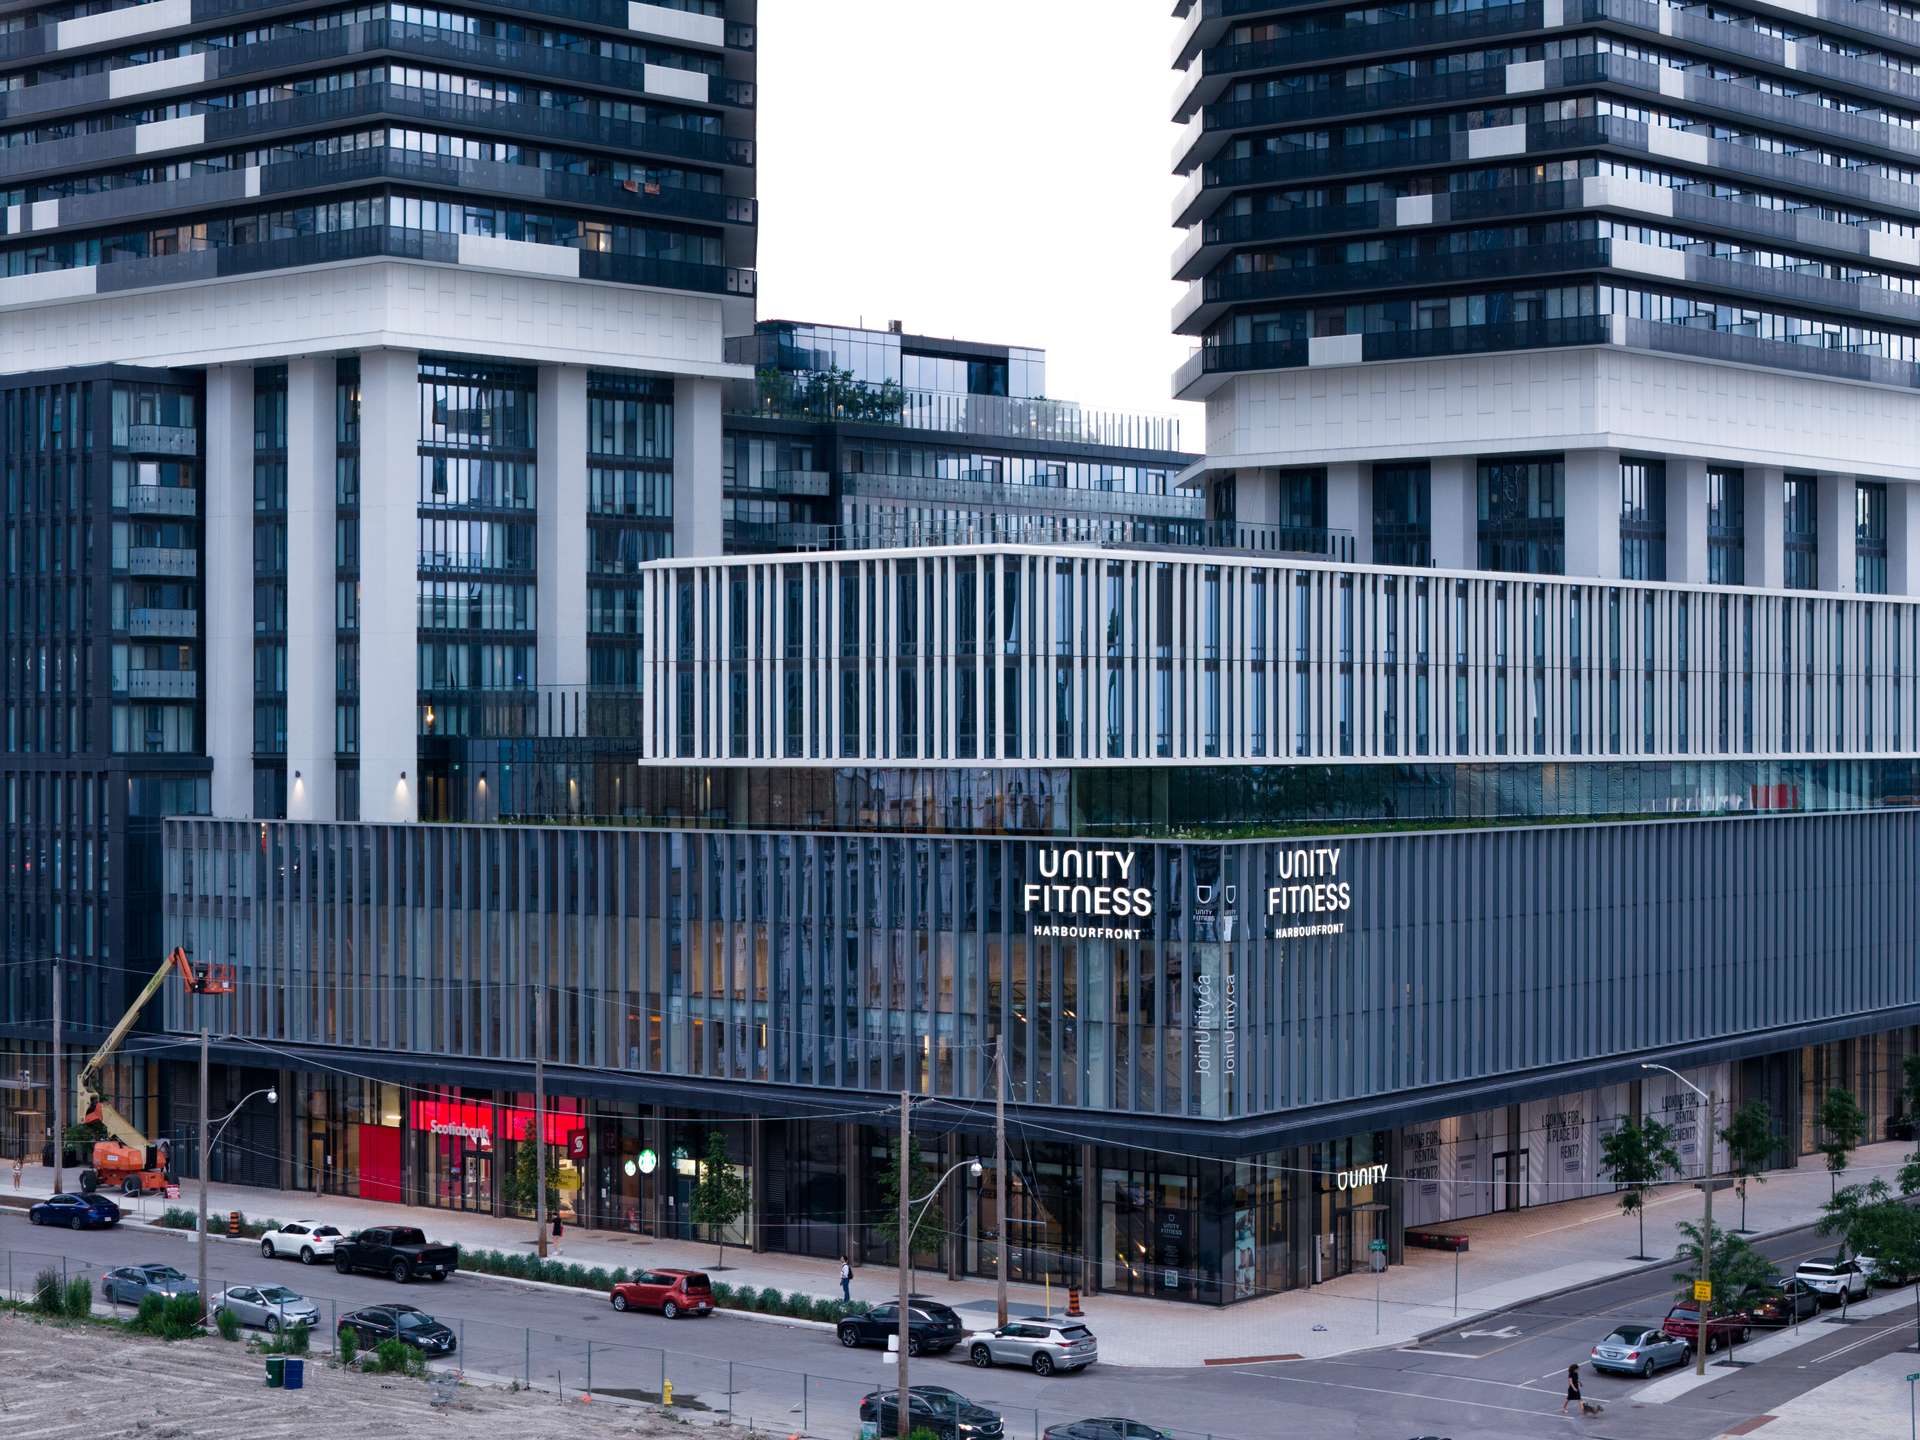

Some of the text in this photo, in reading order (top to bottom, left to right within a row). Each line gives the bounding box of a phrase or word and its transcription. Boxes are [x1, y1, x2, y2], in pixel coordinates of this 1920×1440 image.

[1039, 849, 1135, 879] UNITY
[1279, 848, 1340, 879] UNITY
[1024, 884, 1152, 916] FITNESS
[1269, 882, 1350, 915] FITNESS
[1033, 925, 1141, 940] HARBOURFRONT
[1275, 923, 1344, 939] HARBOURFRONT
[1194, 974, 1214, 1077] JoinUnity.ca
[1224, 974, 1238, 1076] JoinUnity.ca
[430, 1119, 489, 1139] Scotiabank
[1567, 1110, 1580, 1125] FOR
[1349, 1163, 1388, 1188] UNITY
